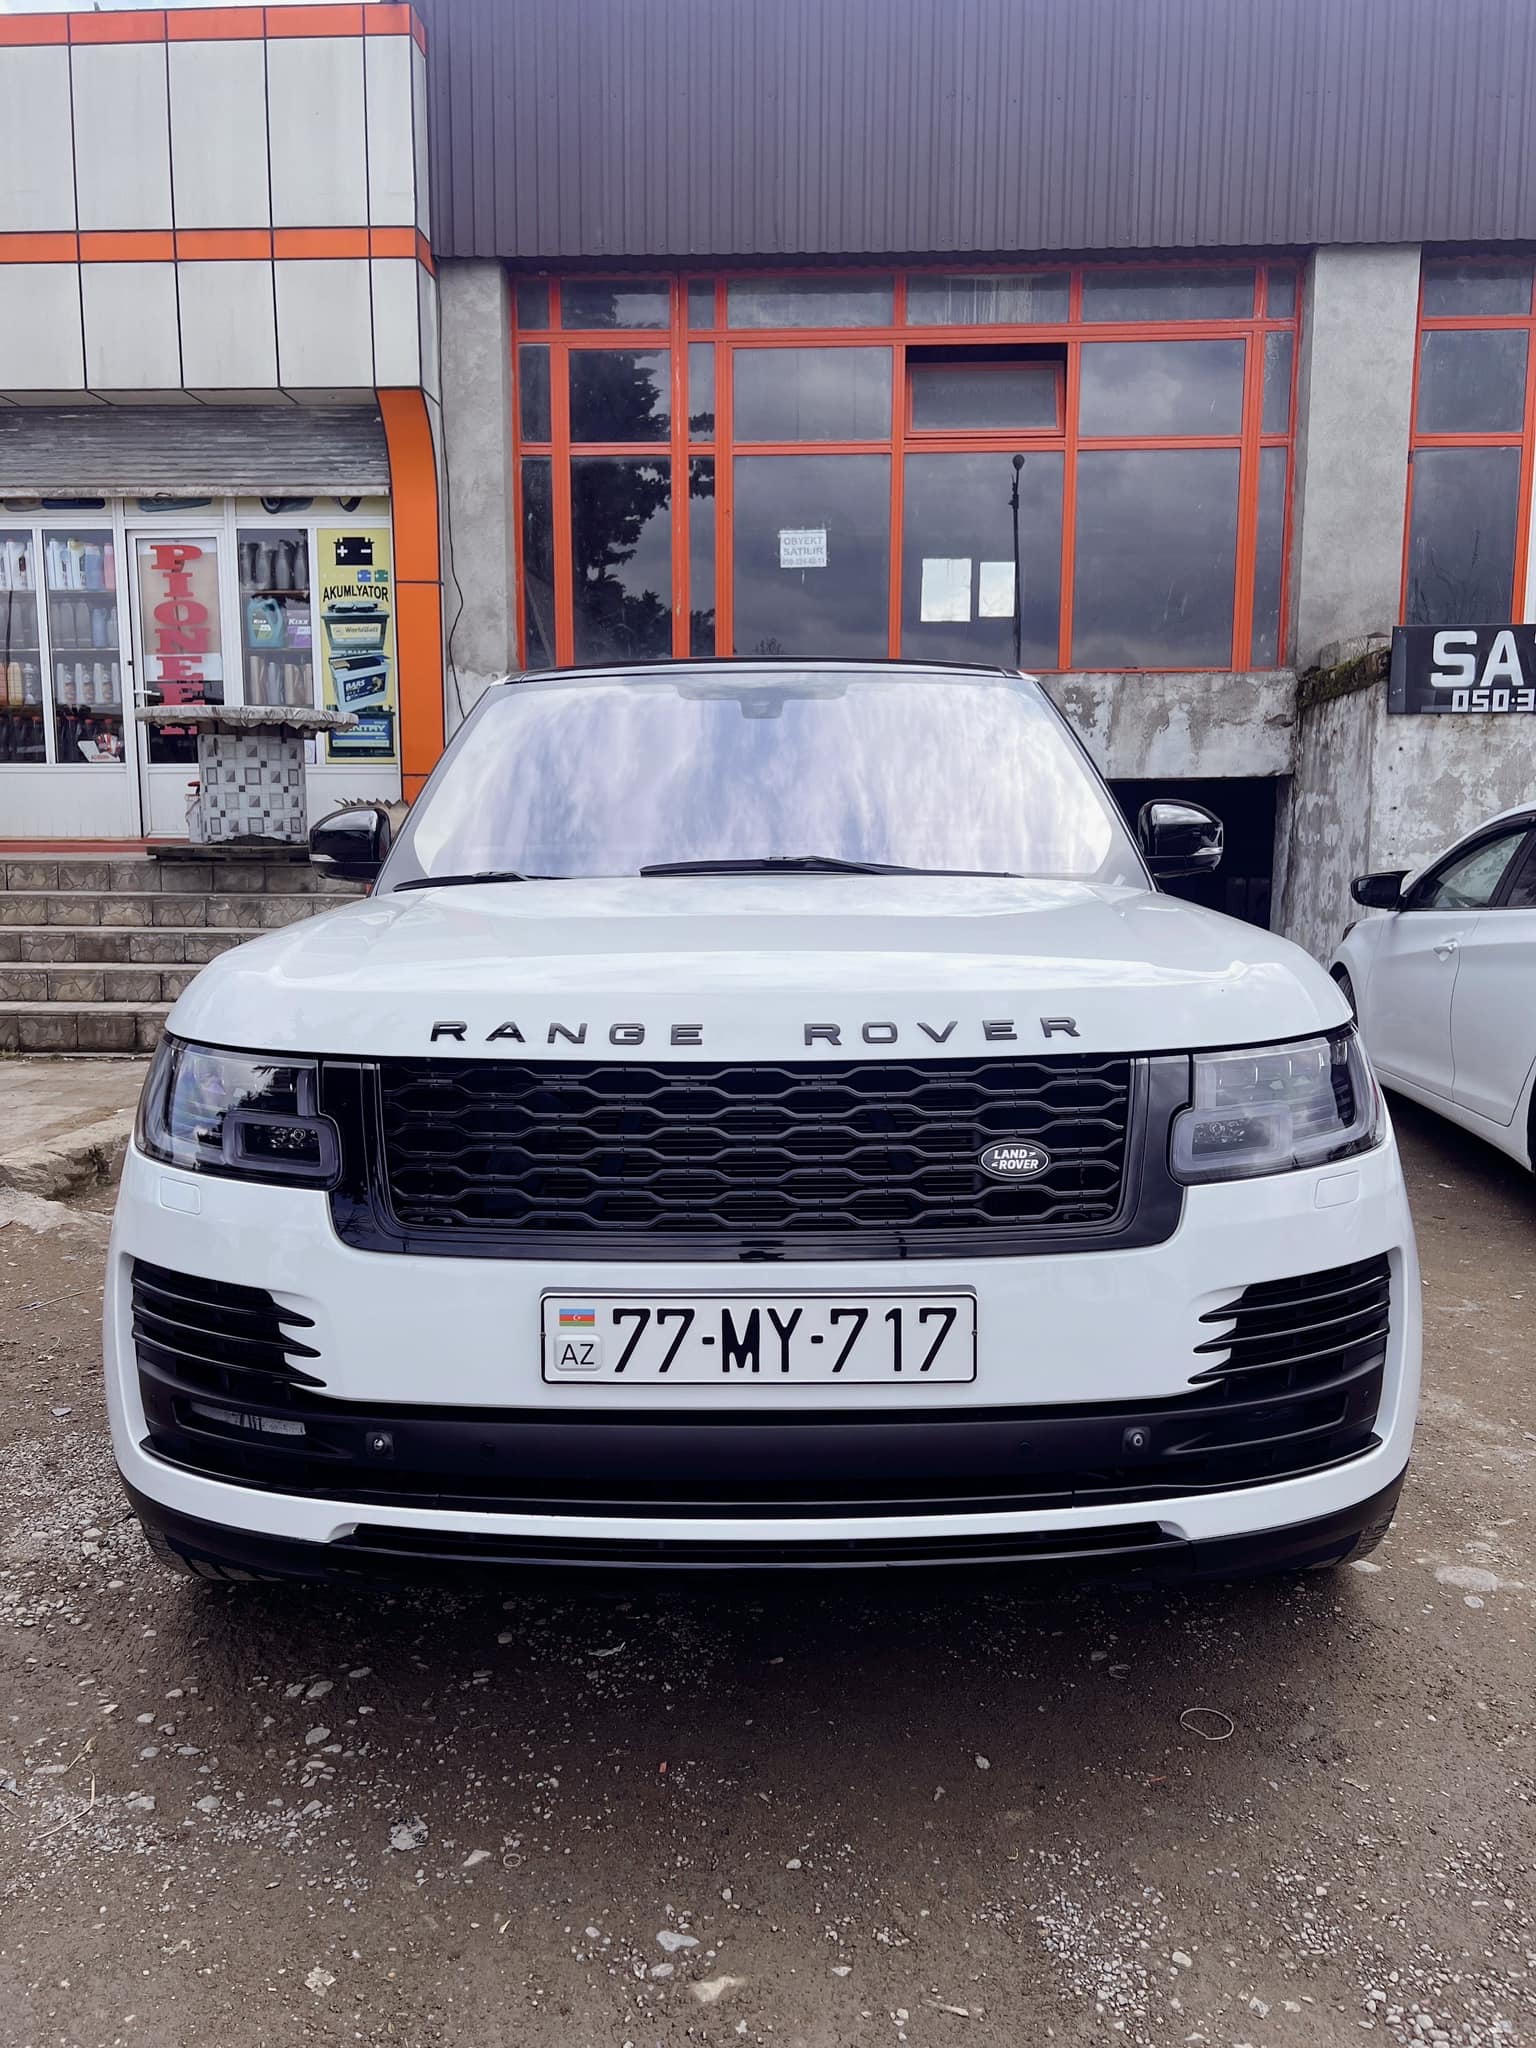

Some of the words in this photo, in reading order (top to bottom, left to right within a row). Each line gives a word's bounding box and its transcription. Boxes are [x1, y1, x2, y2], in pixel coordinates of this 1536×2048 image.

[323, 585, 388, 602] AKUMLYATOR
[150, 545, 210, 736] PIONEE
[1431, 630, 1536, 688] SA
[430, 1020, 703, 1046] RANGE
[804, 1016, 1081, 1046] ROVER
[994, 1149, 1028, 1160] LAND
[998, 1159, 1039, 1170] ROVER
[612, 1307, 958, 1373] 77-MY-717
[560, 1343, 595, 1365] AZ
